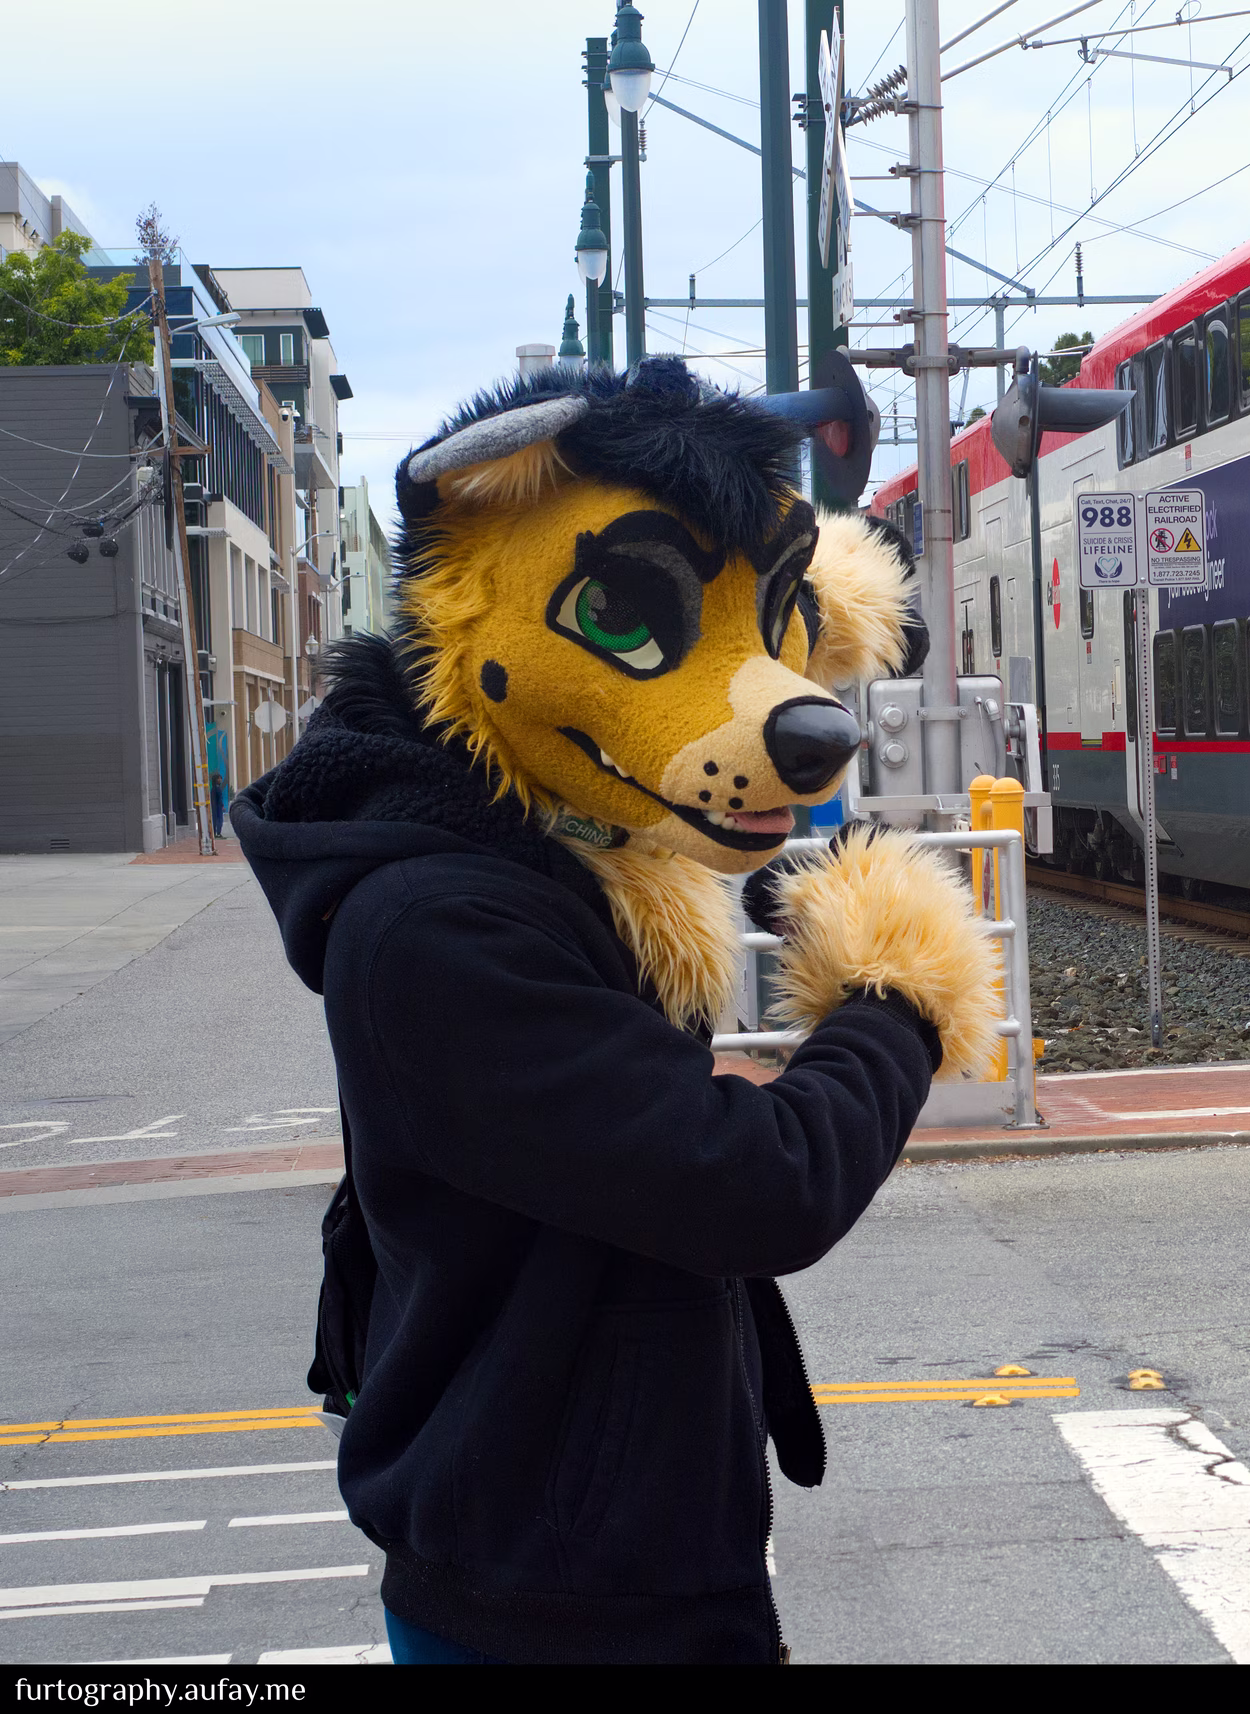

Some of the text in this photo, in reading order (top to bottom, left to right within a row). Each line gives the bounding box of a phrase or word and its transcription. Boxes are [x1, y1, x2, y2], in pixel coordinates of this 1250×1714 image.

[1159, 495, 1190, 503] ACTIVE
[1148, 505, 1202, 514] ELECTRIFIED
[1081, 506, 1132, 528] 988
[1154, 515, 1198, 524] RAILROAD
[1083, 537, 1107, 545] SUICIDE
[1113, 536, 1133, 544] CRISIS
[1083, 545, 1133, 555] LIFELINE
[565, 820, 612, 847] CHING
